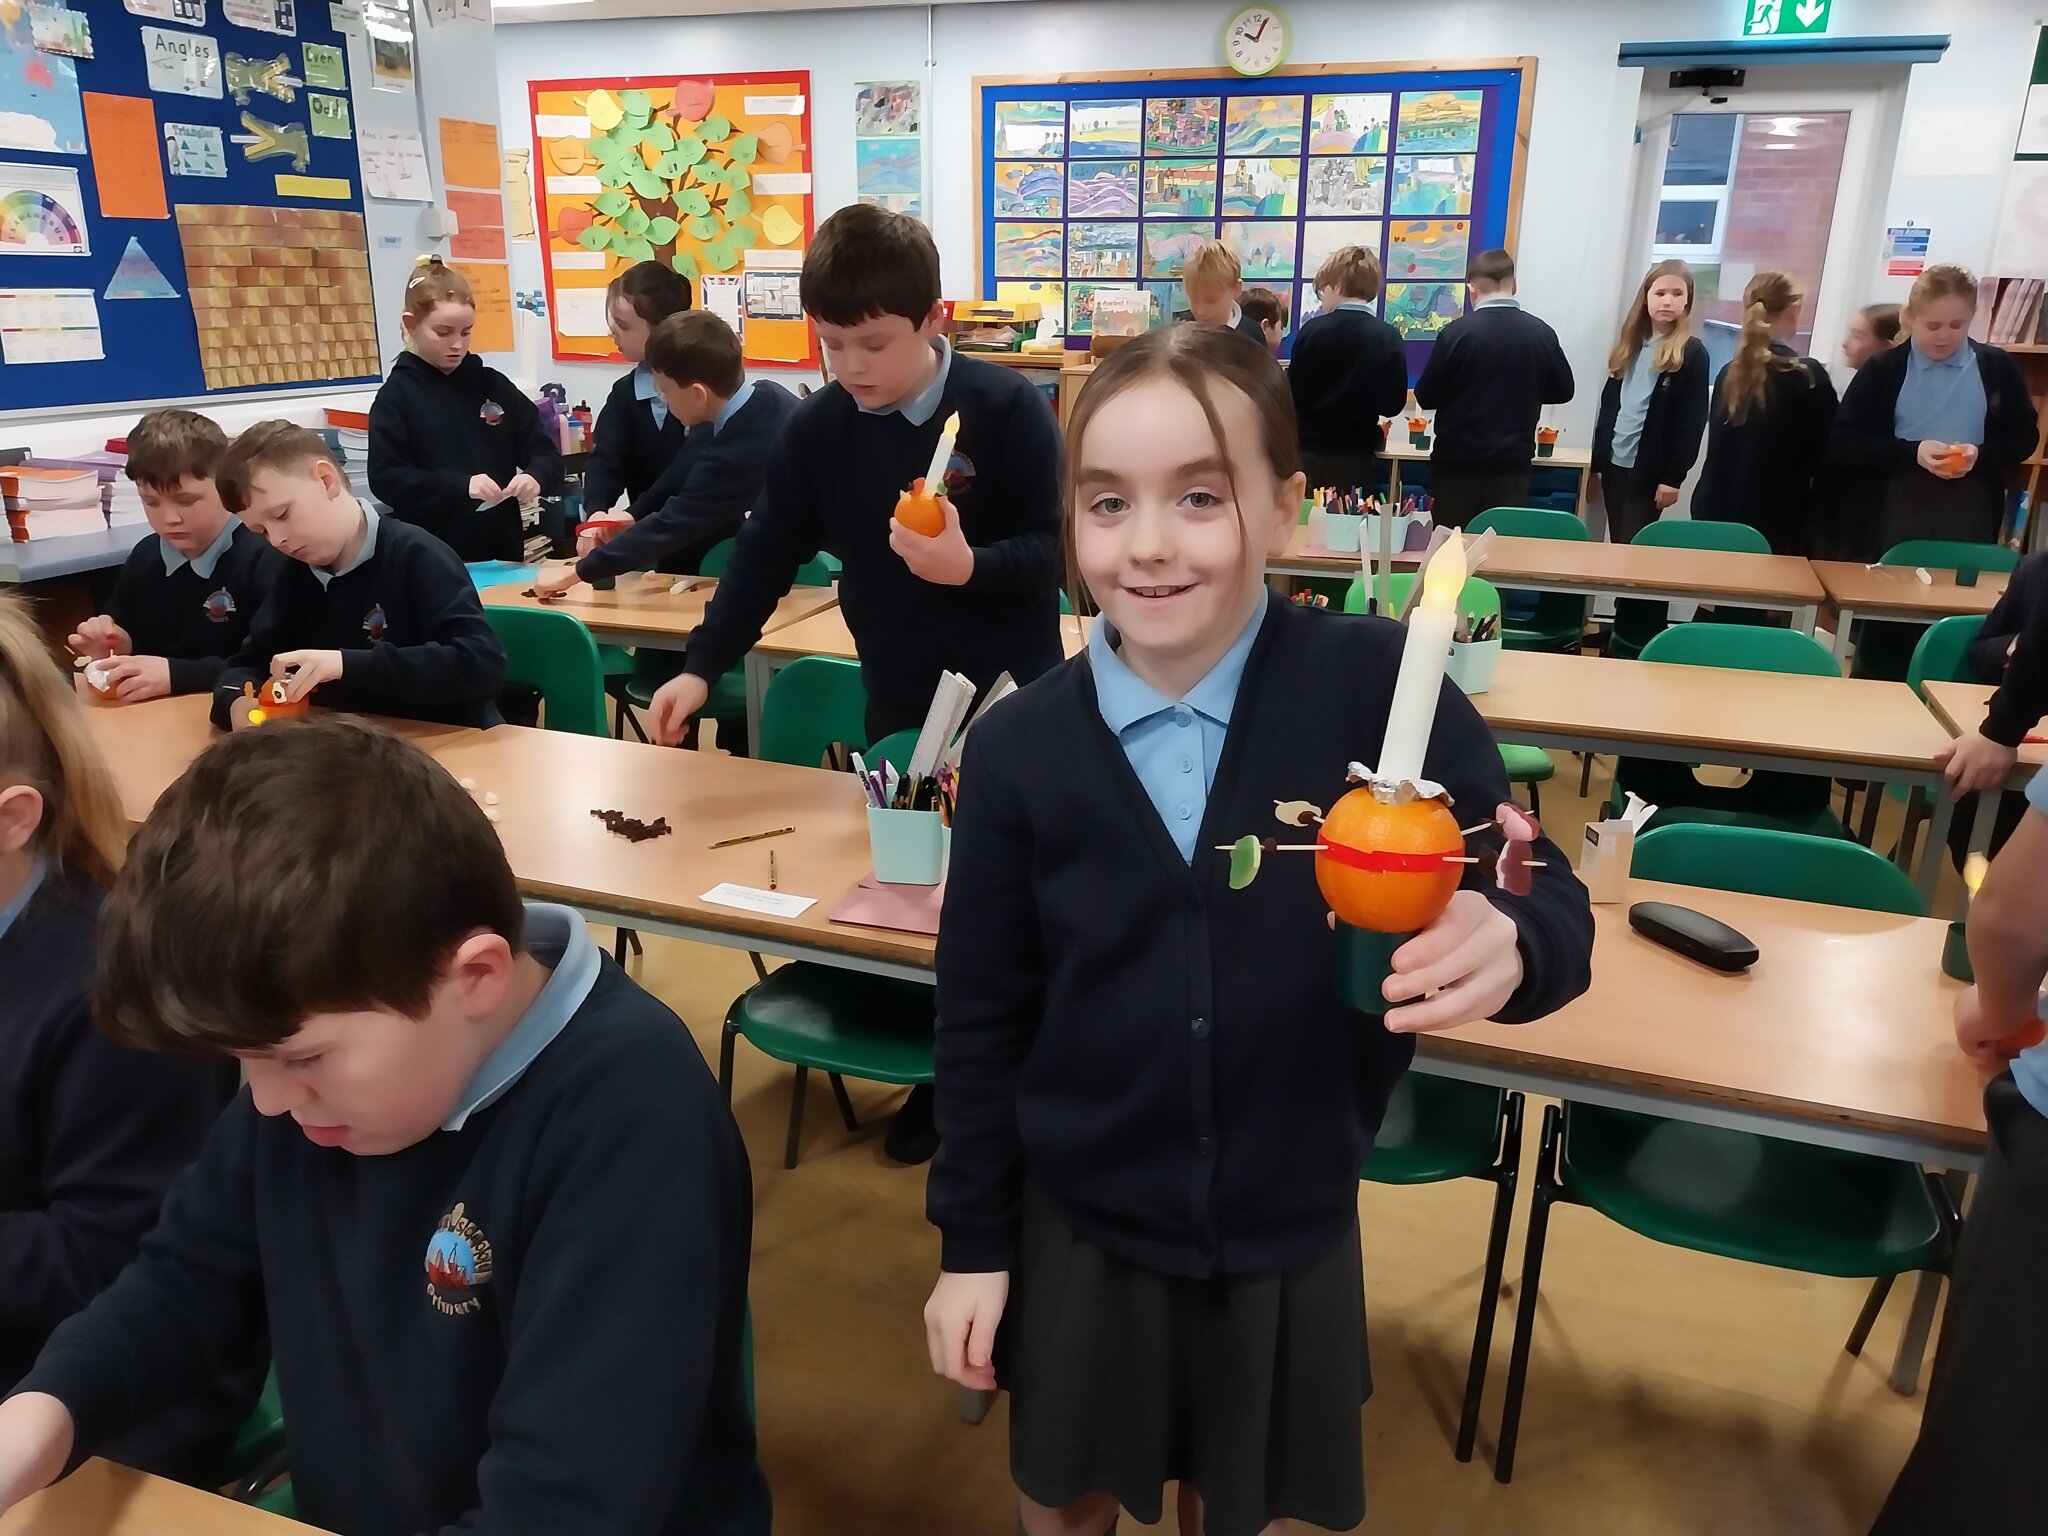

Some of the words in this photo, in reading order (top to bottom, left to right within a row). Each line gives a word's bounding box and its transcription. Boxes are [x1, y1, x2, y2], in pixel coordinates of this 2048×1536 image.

[1253, 14, 1262, 22] 12
[1235, 26, 1244, 36] 10
[155, 33, 210, 62] Angles
